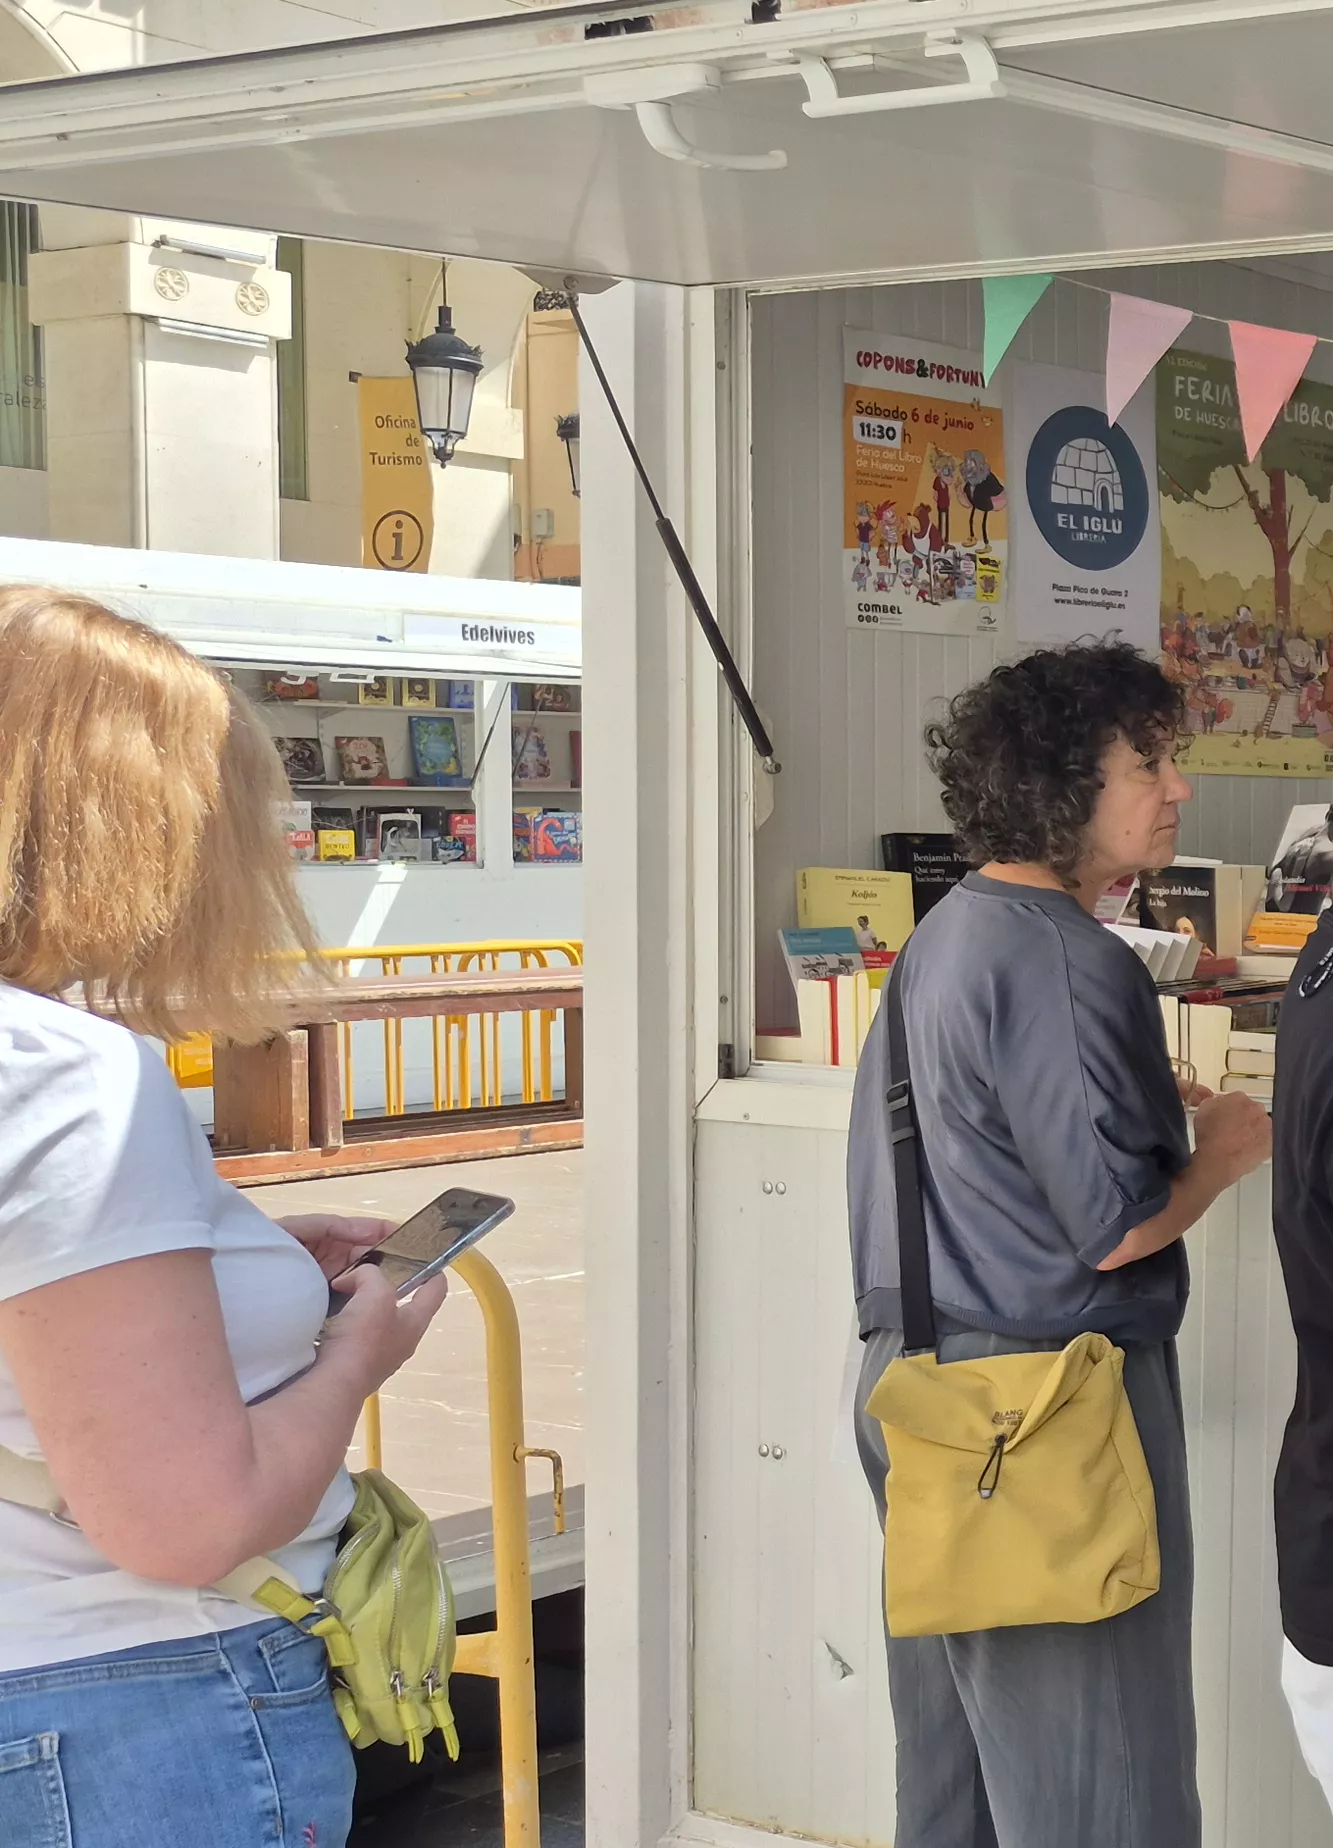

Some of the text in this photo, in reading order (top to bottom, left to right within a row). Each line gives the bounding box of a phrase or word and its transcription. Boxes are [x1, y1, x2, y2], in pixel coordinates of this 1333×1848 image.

[1175, 376, 1234, 408] FERIA
[856, 400, 975, 431] Sábado 6 de junio
[1175, 405, 1192, 421] DE
[375, 414, 417, 429] Oficina
[405, 433, 421, 447] de
[859, 422, 912, 445] 11:30 h
[369, 451, 423, 466] Turismo
[899, 450, 922, 464] Libro
[856, 457, 868, 468] de
[871, 459, 905, 474] Huesca
[1057, 513, 1078, 530] EL
[461, 623, 535, 645] Edelvives
[1170, 886, 1182, 896] del
[1183, 886, 1210, 897] Molino
